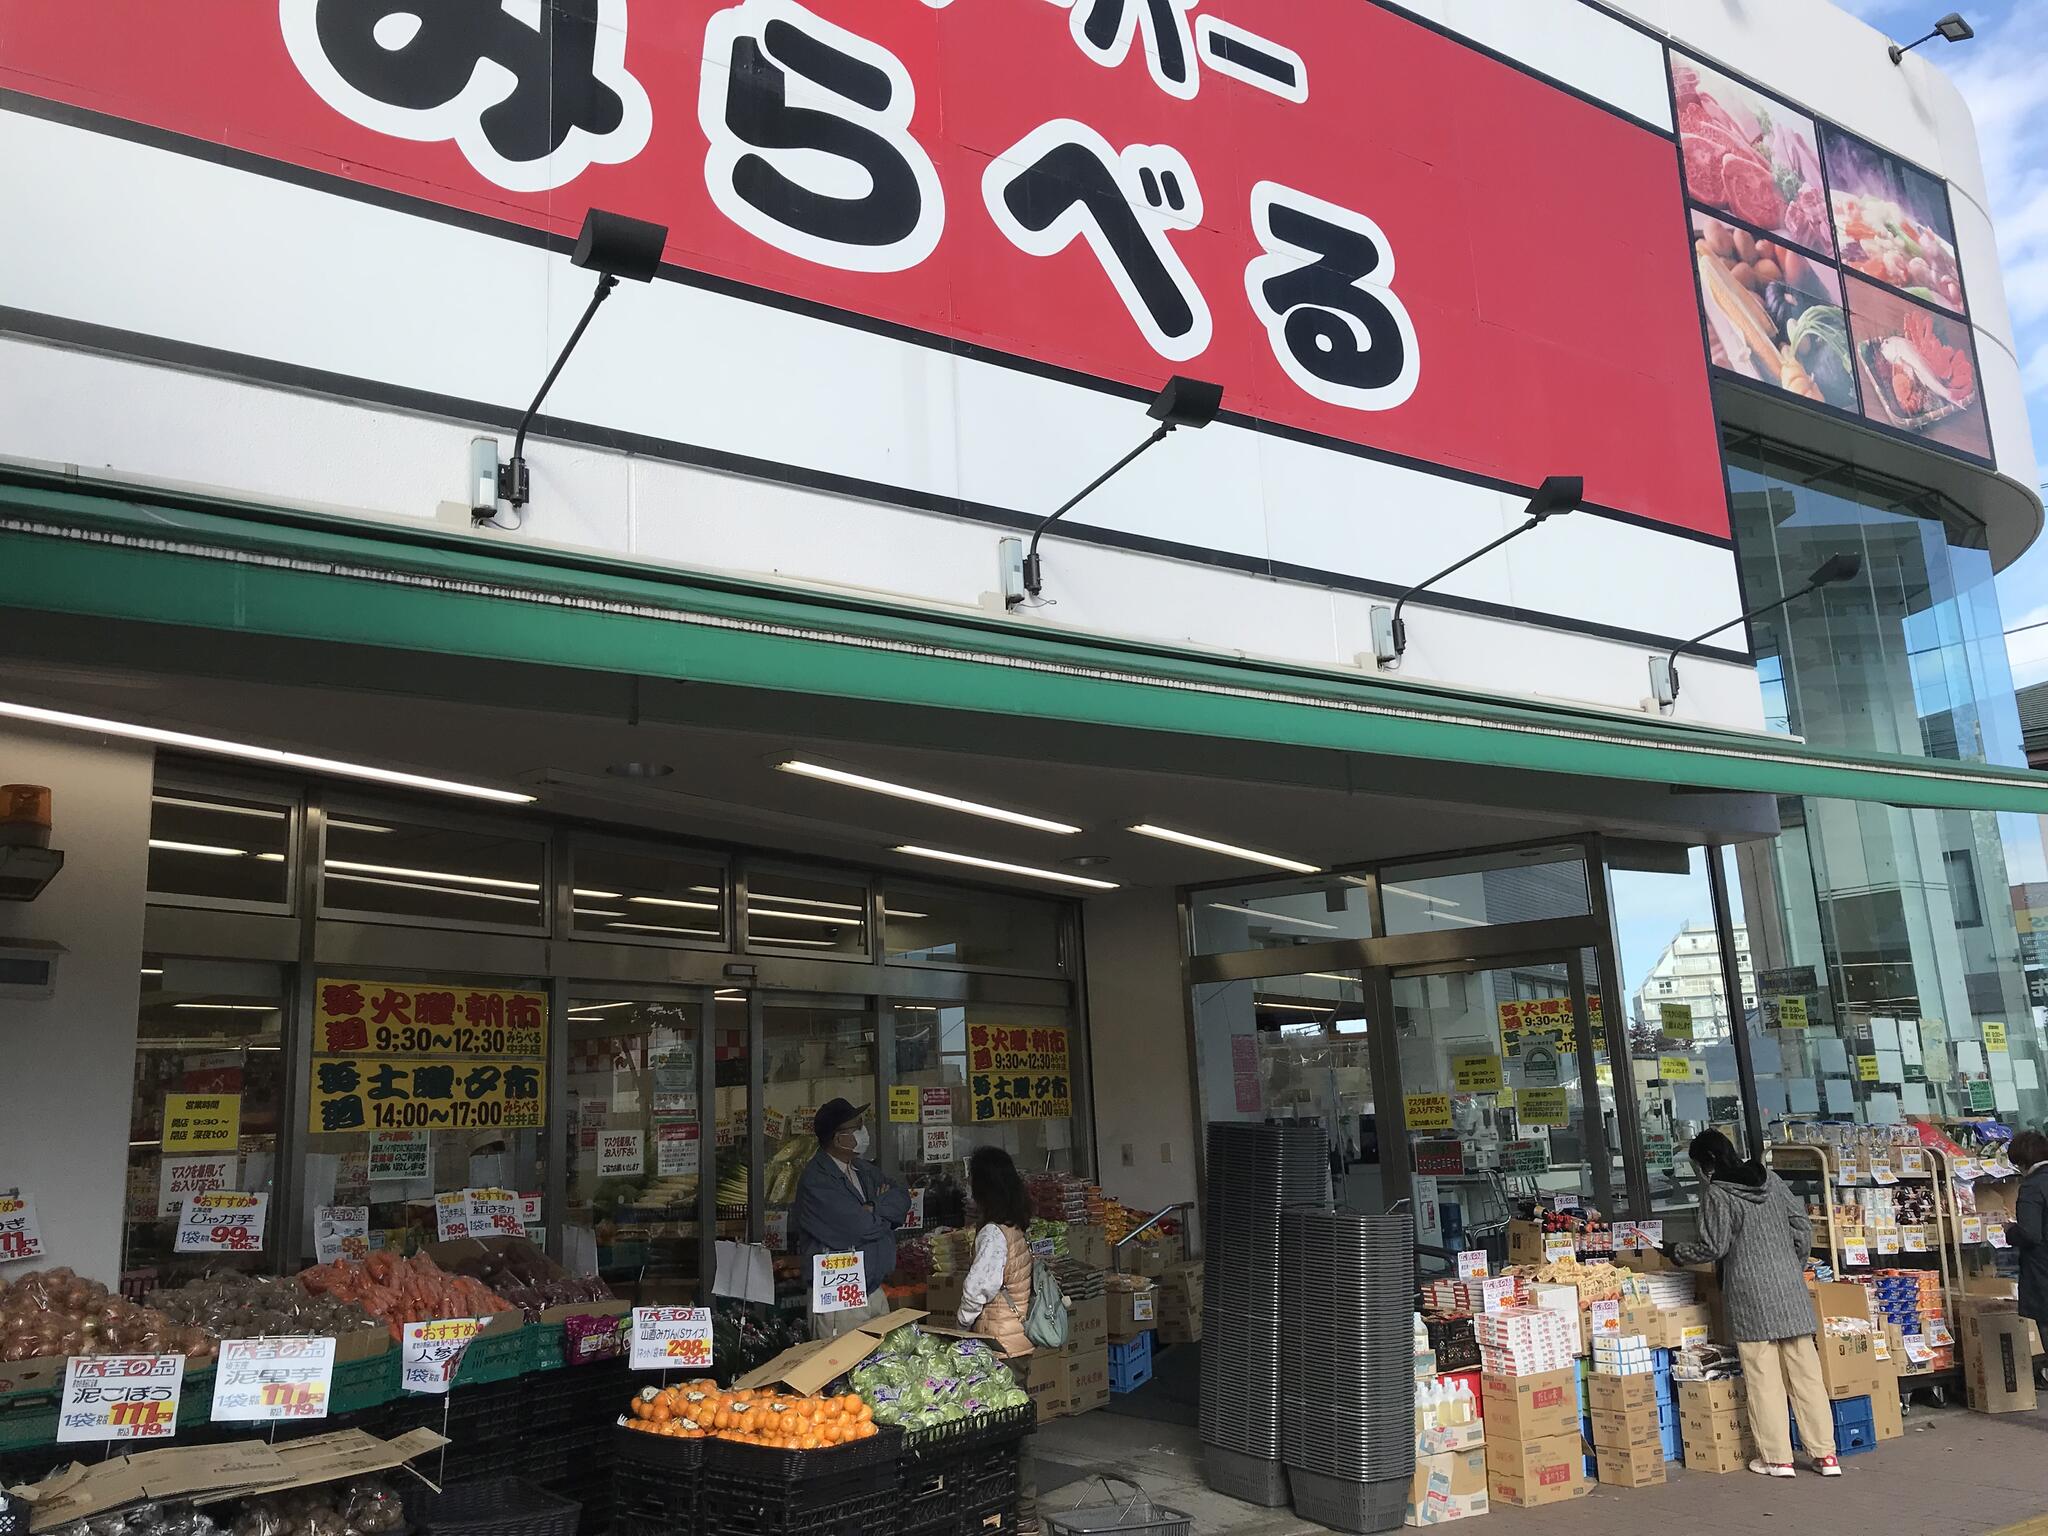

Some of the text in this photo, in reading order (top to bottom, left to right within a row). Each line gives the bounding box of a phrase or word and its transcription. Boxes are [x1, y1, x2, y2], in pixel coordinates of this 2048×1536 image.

[295, 0, 1415, 404] みらべる
[370, 988, 542, 1028] 火曜・朝市
[506, 1031, 542, 1044] みらべる
[506, 1044, 542, 1055] 中井店
[366, 1064, 540, 1100] 土曜・夕市
[185, 1100, 221, 1110] 営業時間
[503, 1100, 540, 1114] みらべる
[503, 1113, 540, 1126] 中井店
[823, 1272, 860, 1287] レタス
[640, 1309, 707, 1322] 広告の品
[228, 1340, 326, 1360] 広告の品
[667, 1340, 711, 1357] 298円
[75, 1358, 177, 1378] 広告の品
[224, 1367, 324, 1386] 泥里芋
[72, 1386, 173, 1404] 泥ごぼう
[262, 1383, 325, 1406] 111円
[111, 1402, 174, 1426] 111円
